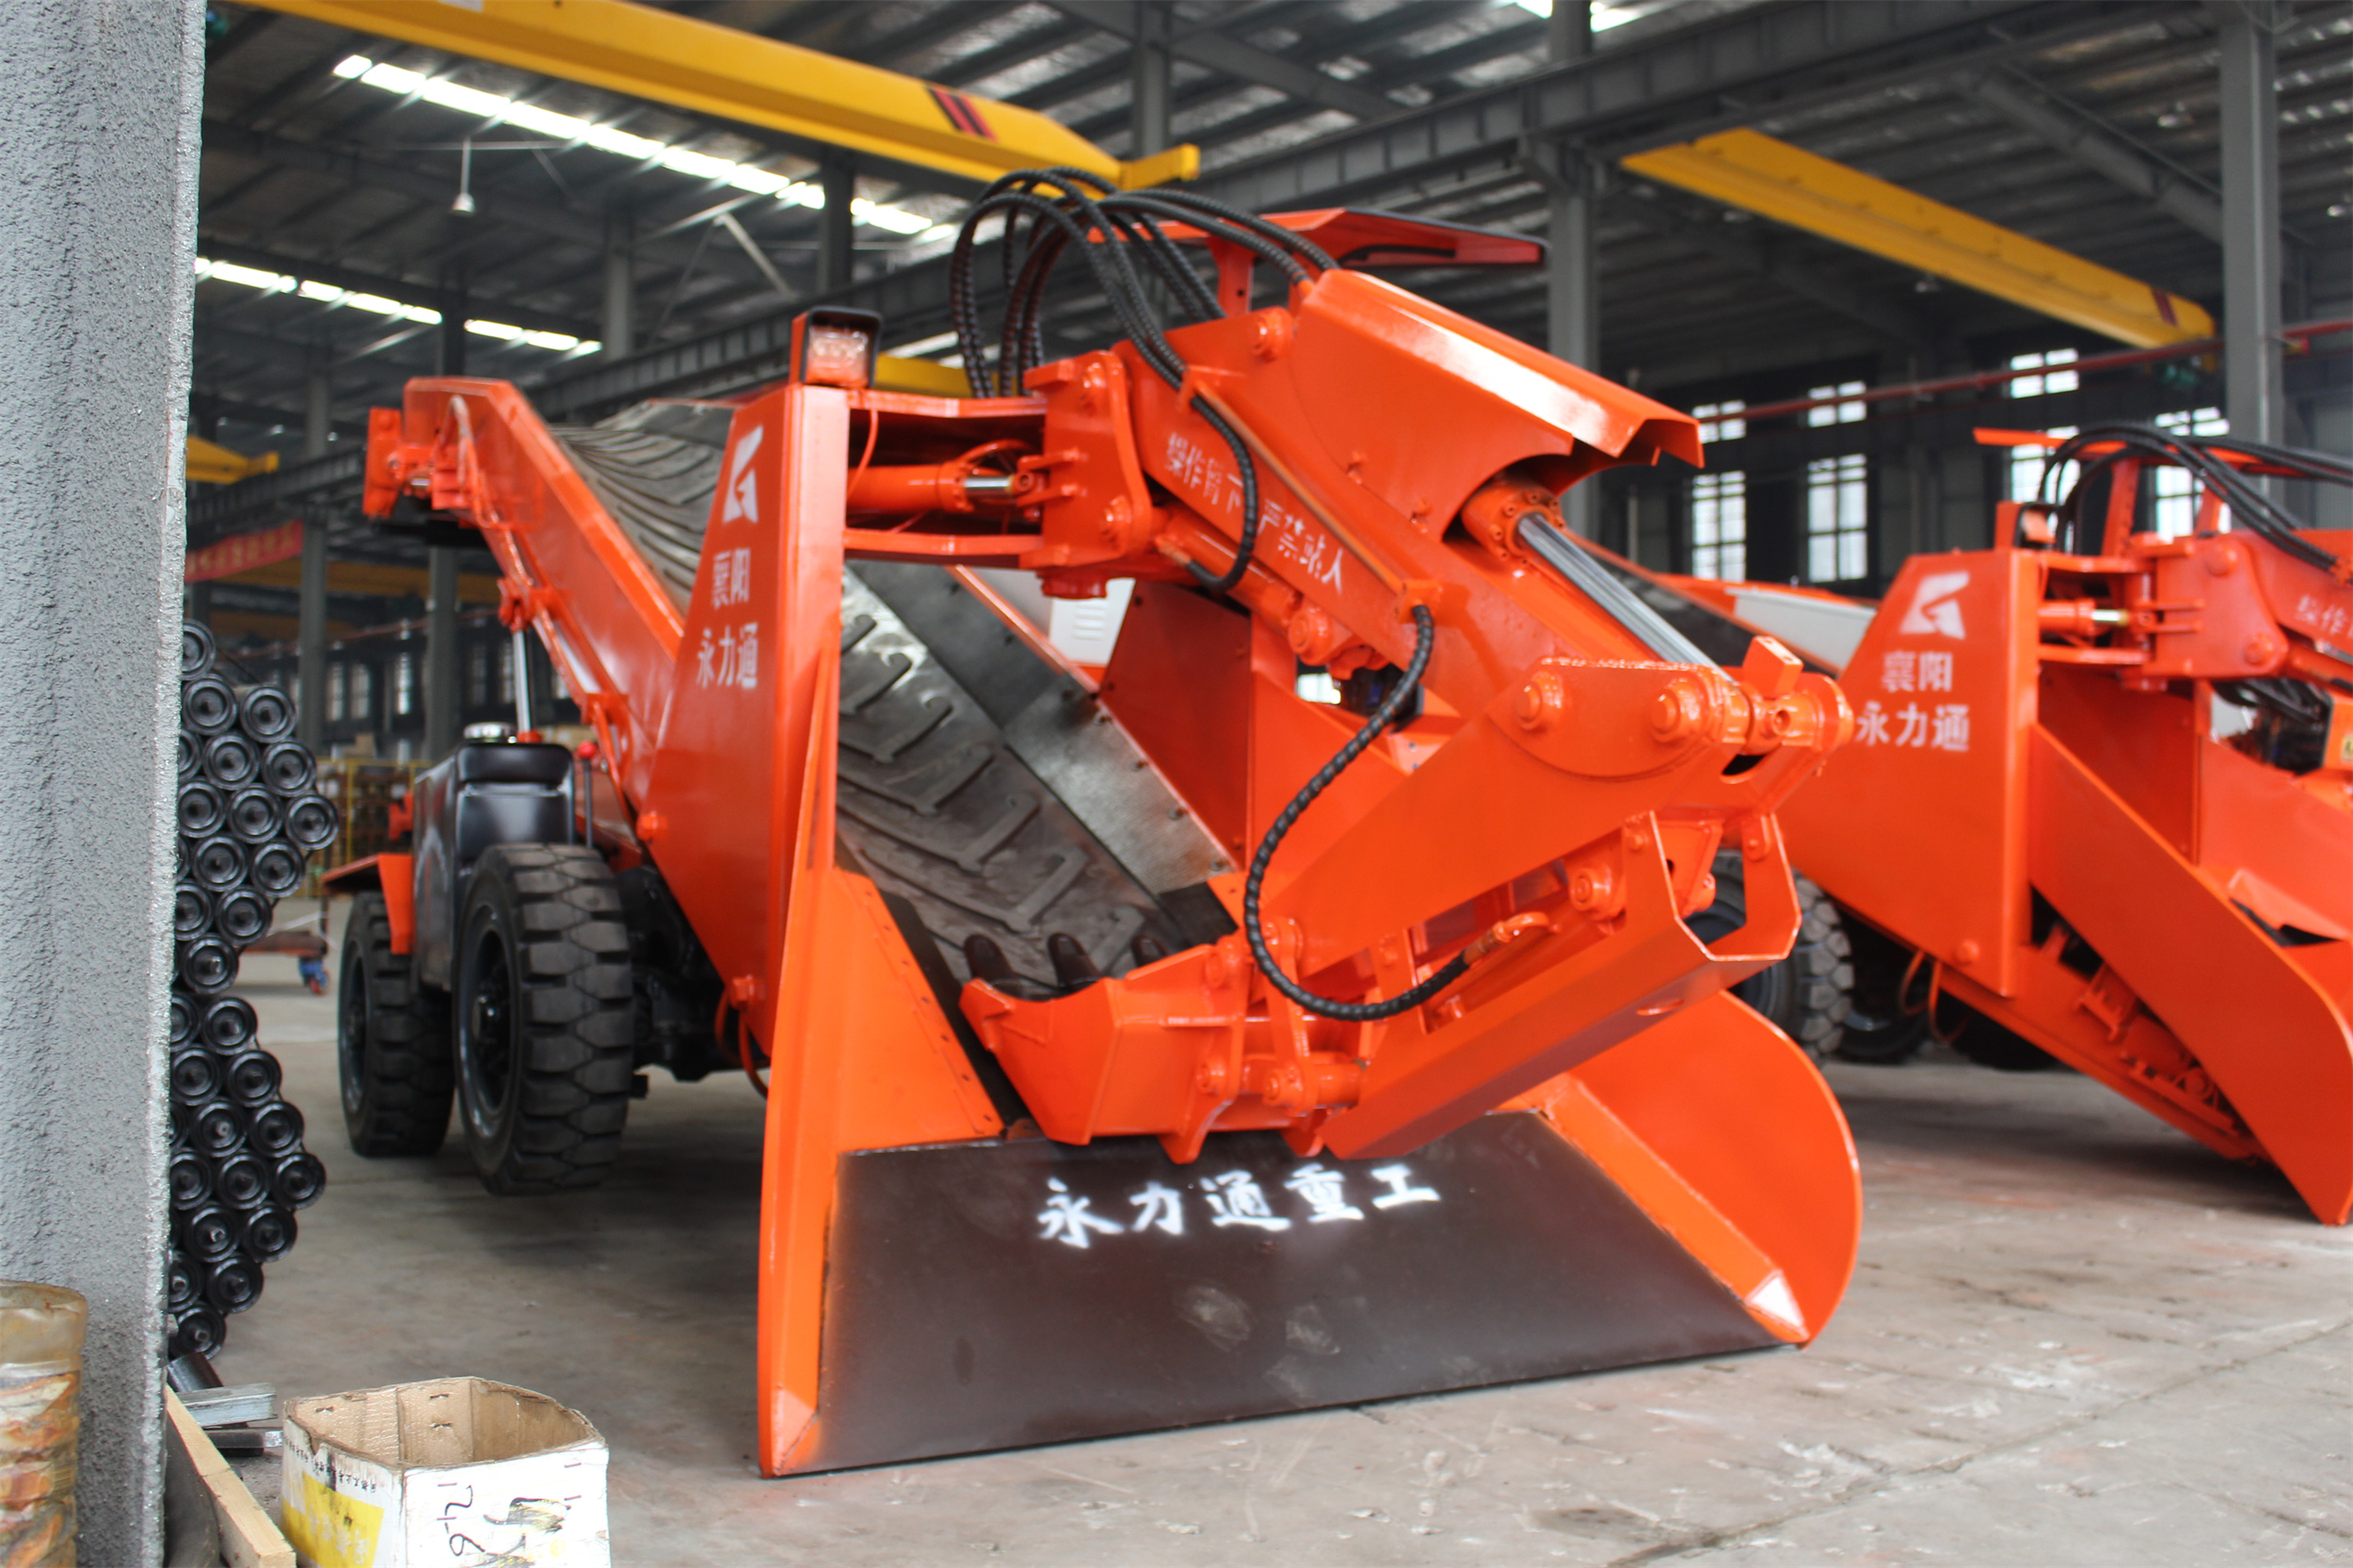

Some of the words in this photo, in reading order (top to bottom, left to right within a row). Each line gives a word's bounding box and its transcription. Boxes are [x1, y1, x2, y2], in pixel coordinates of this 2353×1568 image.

[712, 547, 751, 610] 襄阳
[696, 621, 760, 690] 永力通
[1881, 648, 1954, 694] 襄阳
[1854, 699, 1971, 753] 永力通
[1036, 1162, 1442, 1250] 永力通重工
